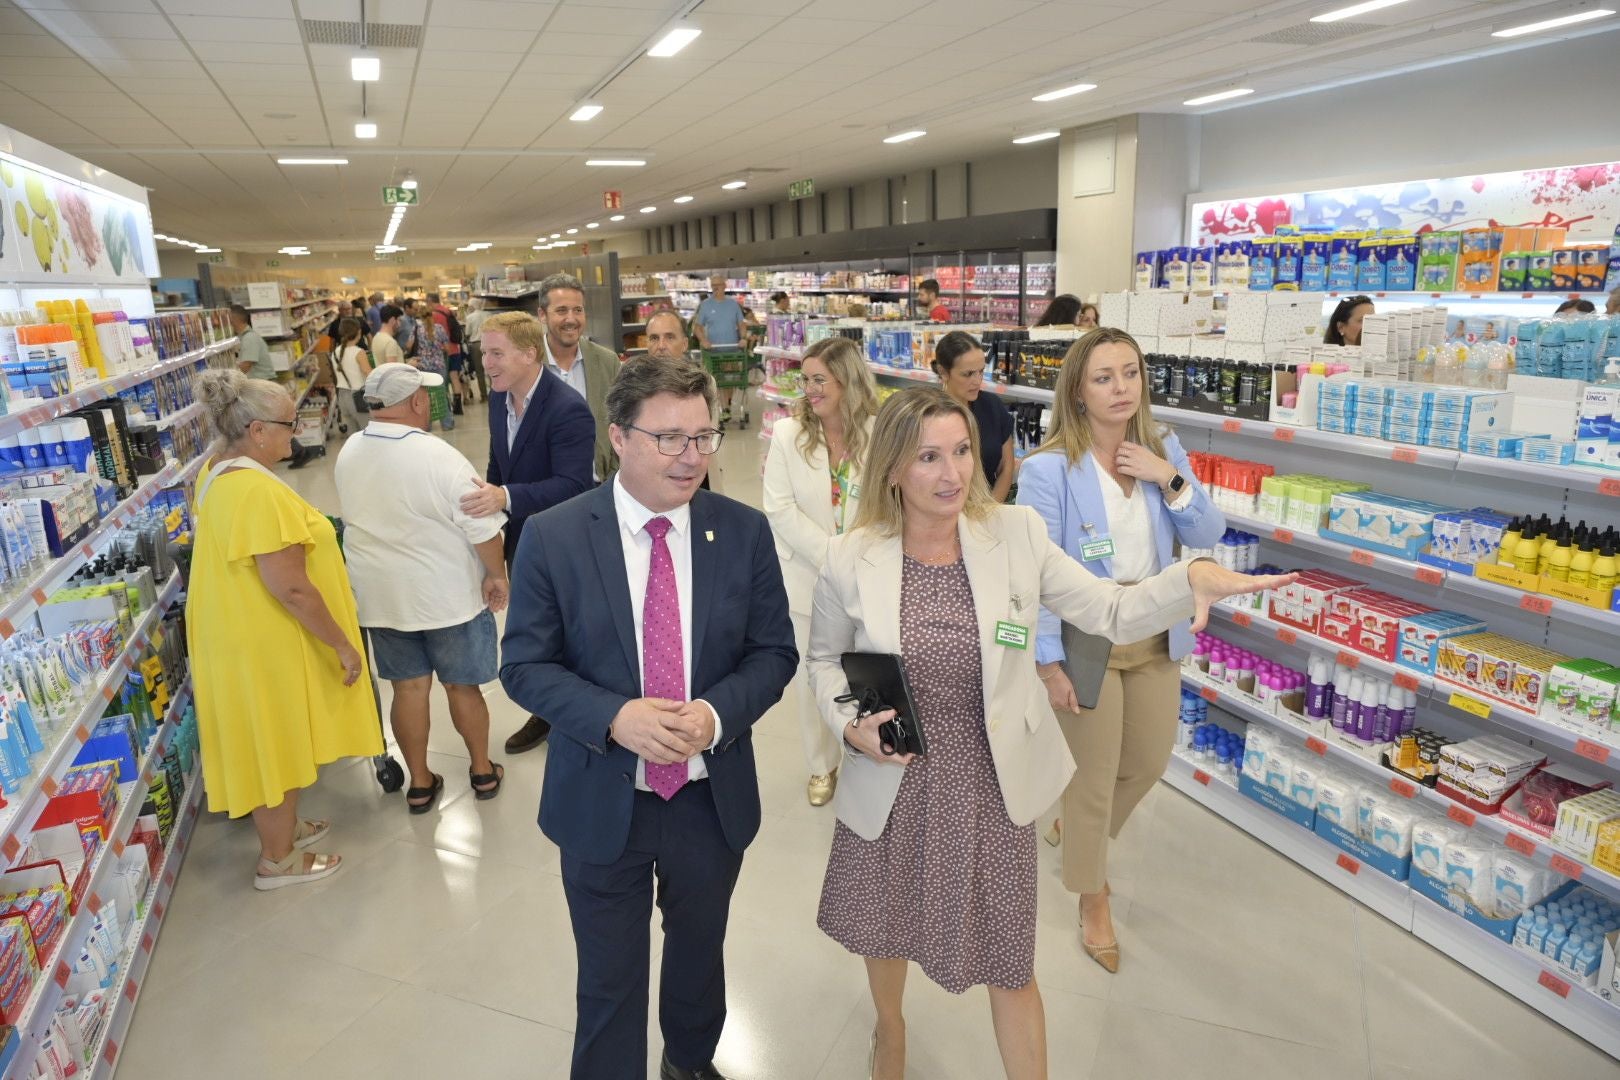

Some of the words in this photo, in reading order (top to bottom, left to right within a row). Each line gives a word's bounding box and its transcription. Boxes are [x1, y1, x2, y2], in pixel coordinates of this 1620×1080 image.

[1467, 333, 1475, 343] 3
[1509, 336, 1516, 346] 3
[102, 443, 116, 478] NORMAL
[73, 814, 99, 823] Colgate
[35, 905, 57, 936] Colgate
